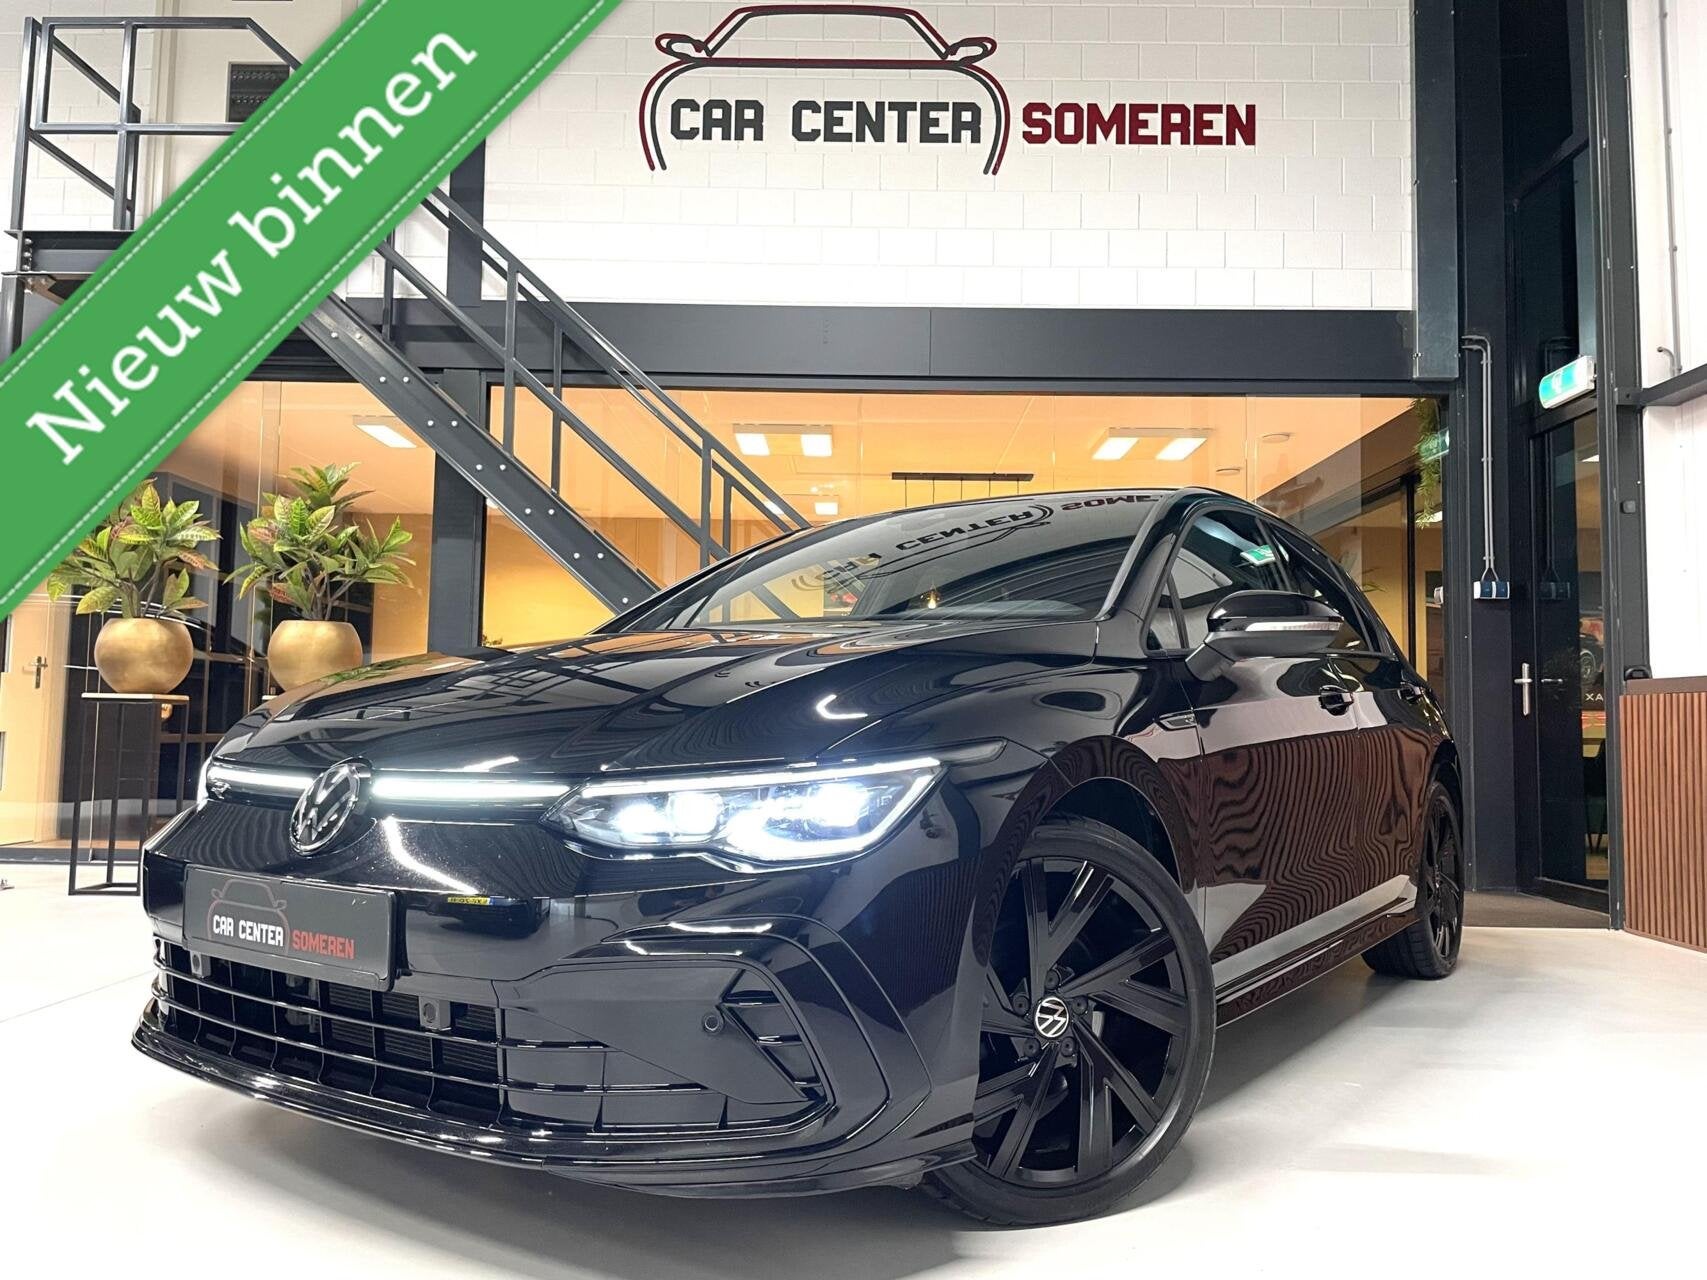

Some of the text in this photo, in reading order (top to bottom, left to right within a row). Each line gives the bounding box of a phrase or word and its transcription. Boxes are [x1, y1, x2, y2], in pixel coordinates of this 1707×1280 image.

[670, 98, 1257, 146] CAR CENTER SOMEREN
[212, 914, 355, 960] CAR CENTER SOMEREN
